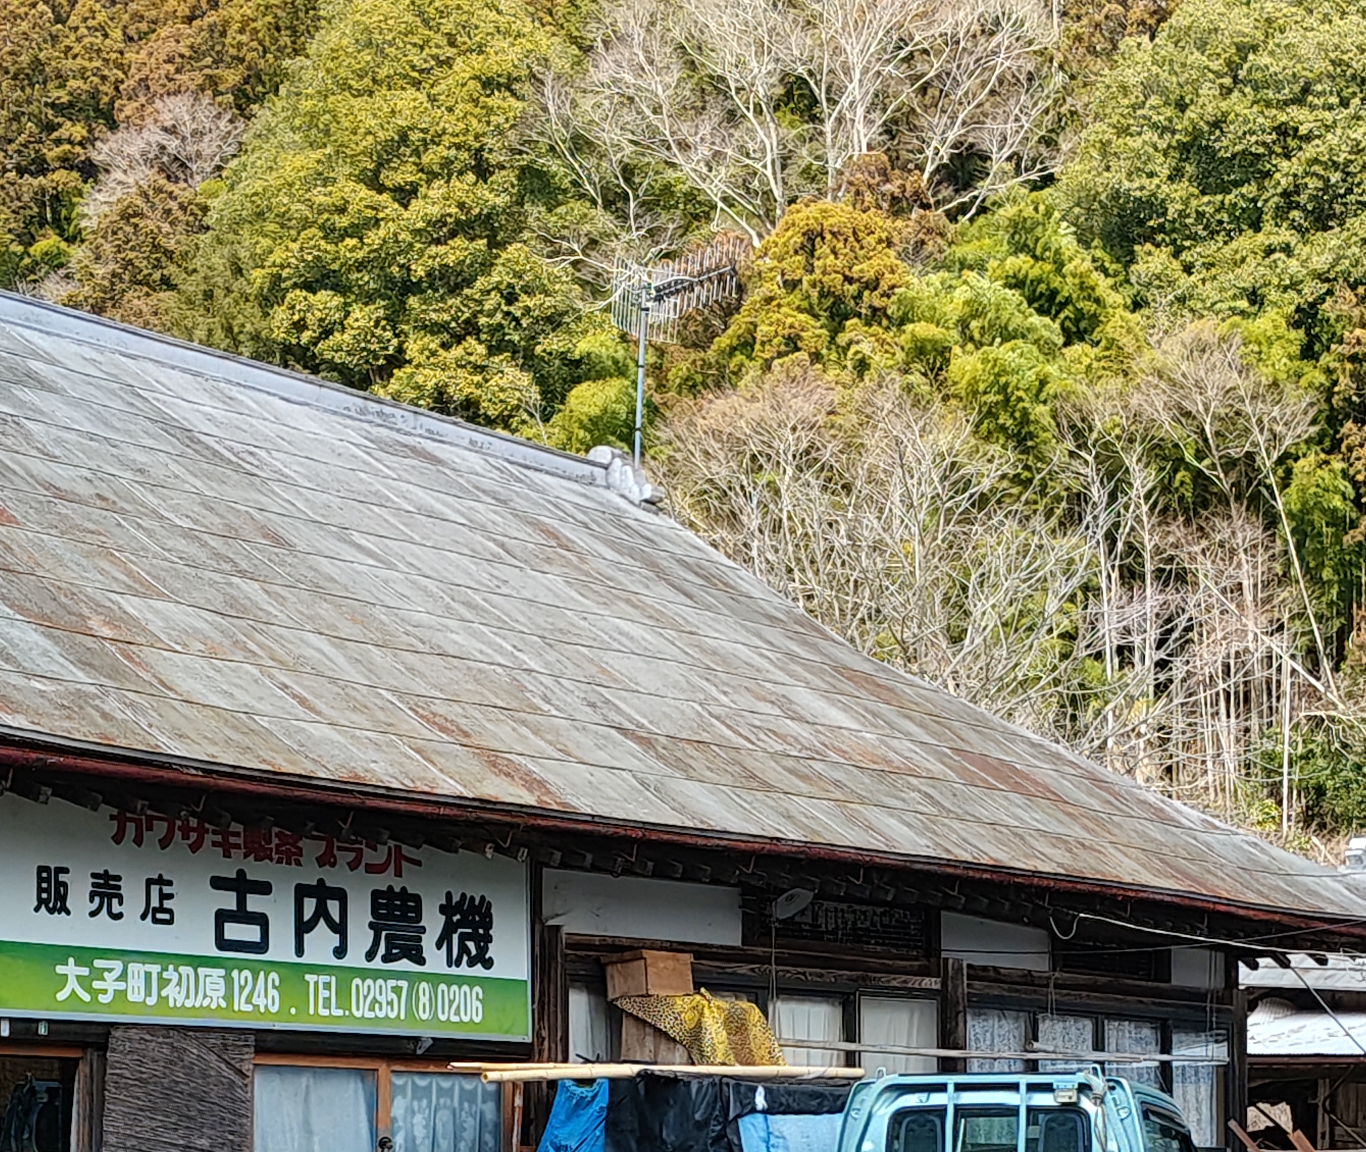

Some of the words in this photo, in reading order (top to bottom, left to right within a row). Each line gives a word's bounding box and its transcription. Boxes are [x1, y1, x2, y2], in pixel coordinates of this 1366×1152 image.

[33, 865, 175, 926] 販売店
[209, 868, 495, 970] 古内農機
